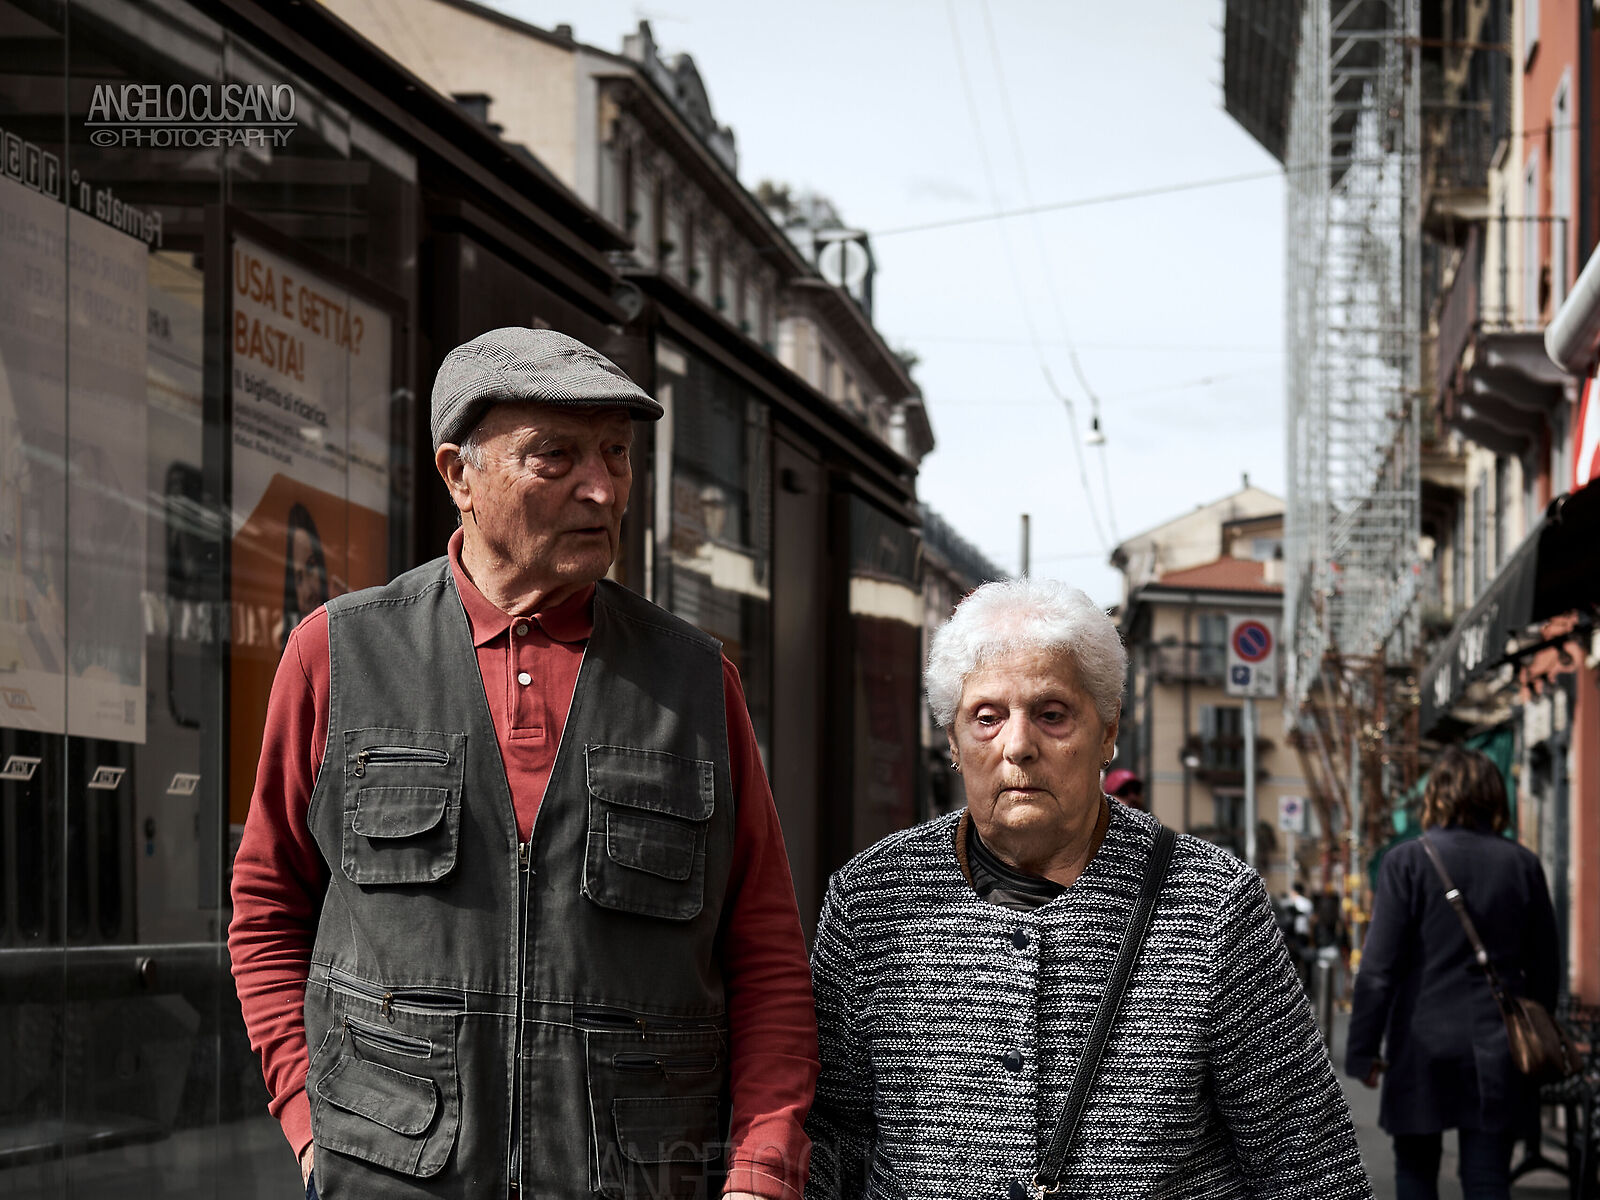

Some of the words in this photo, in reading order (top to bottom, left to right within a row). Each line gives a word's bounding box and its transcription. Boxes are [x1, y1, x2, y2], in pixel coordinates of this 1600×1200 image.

[234, 250, 277, 313] USA
[282, 275, 293, 320] E
[299, 285, 364, 356] GETTA?
[234, 310, 305, 382] BASTA!
